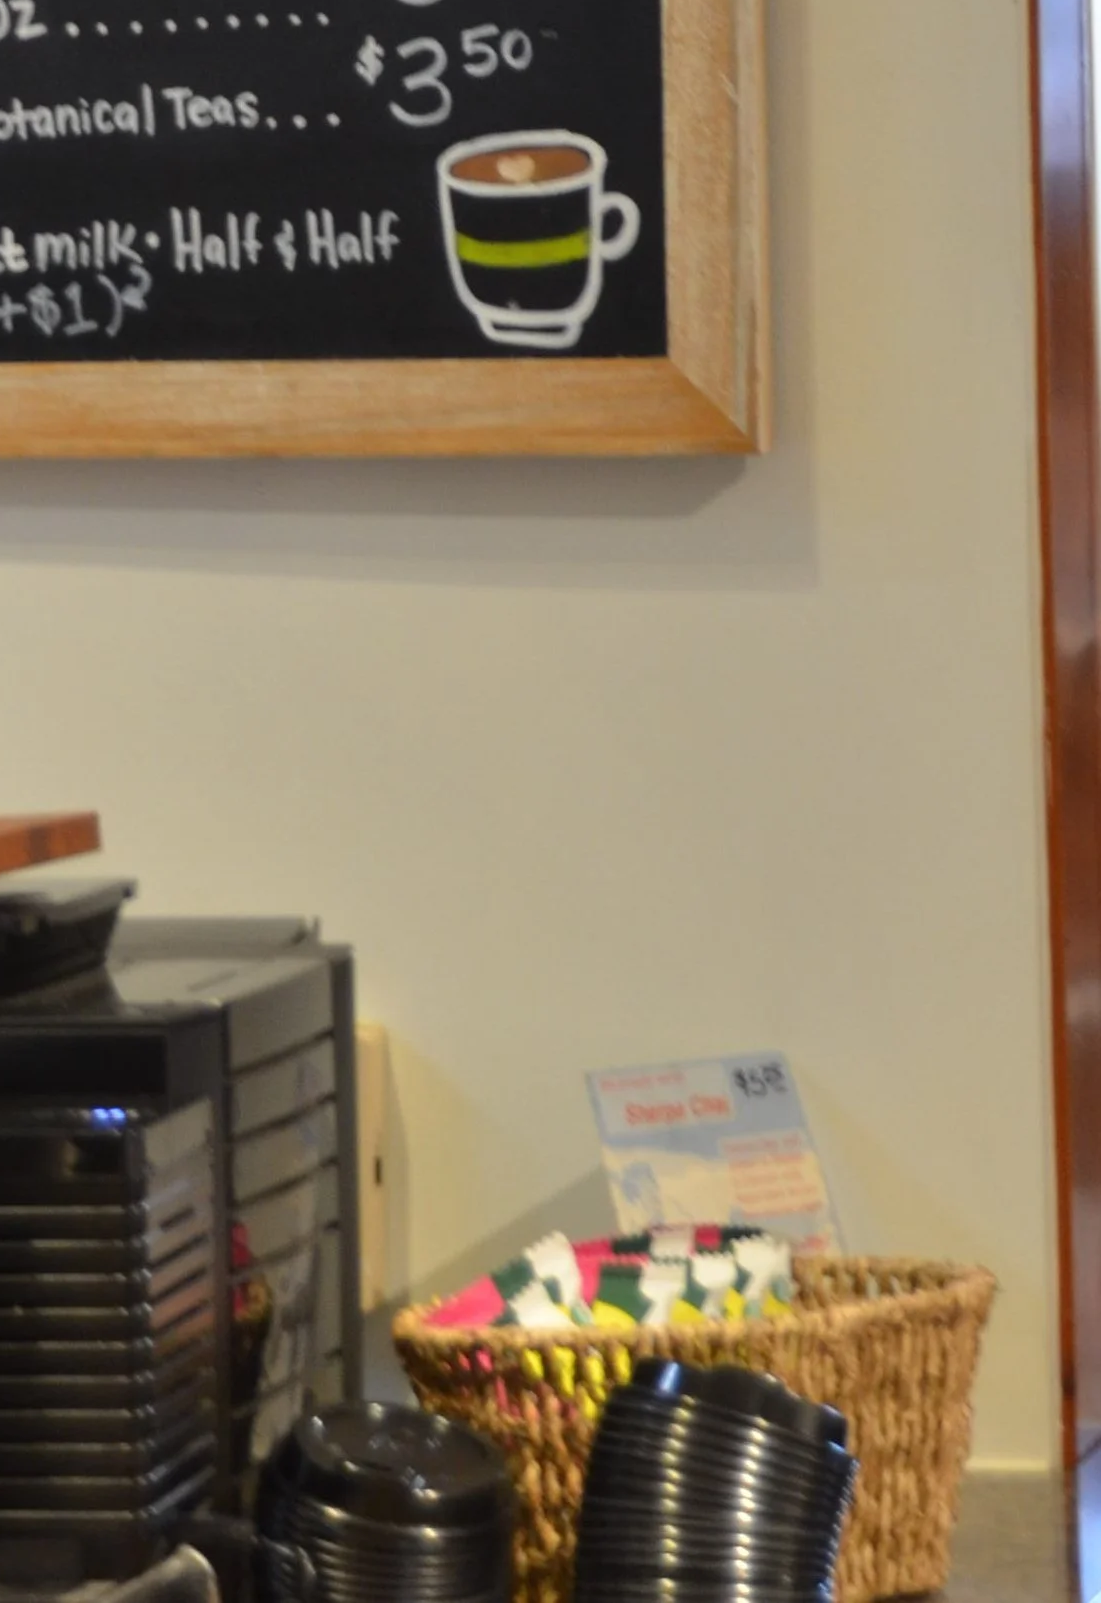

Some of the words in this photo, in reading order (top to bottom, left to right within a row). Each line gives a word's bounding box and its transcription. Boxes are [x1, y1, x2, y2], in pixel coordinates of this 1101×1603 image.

[35, 221, 143, 273] milk
[172, 206, 262, 273] Half
[308, 208, 401, 268] Half
